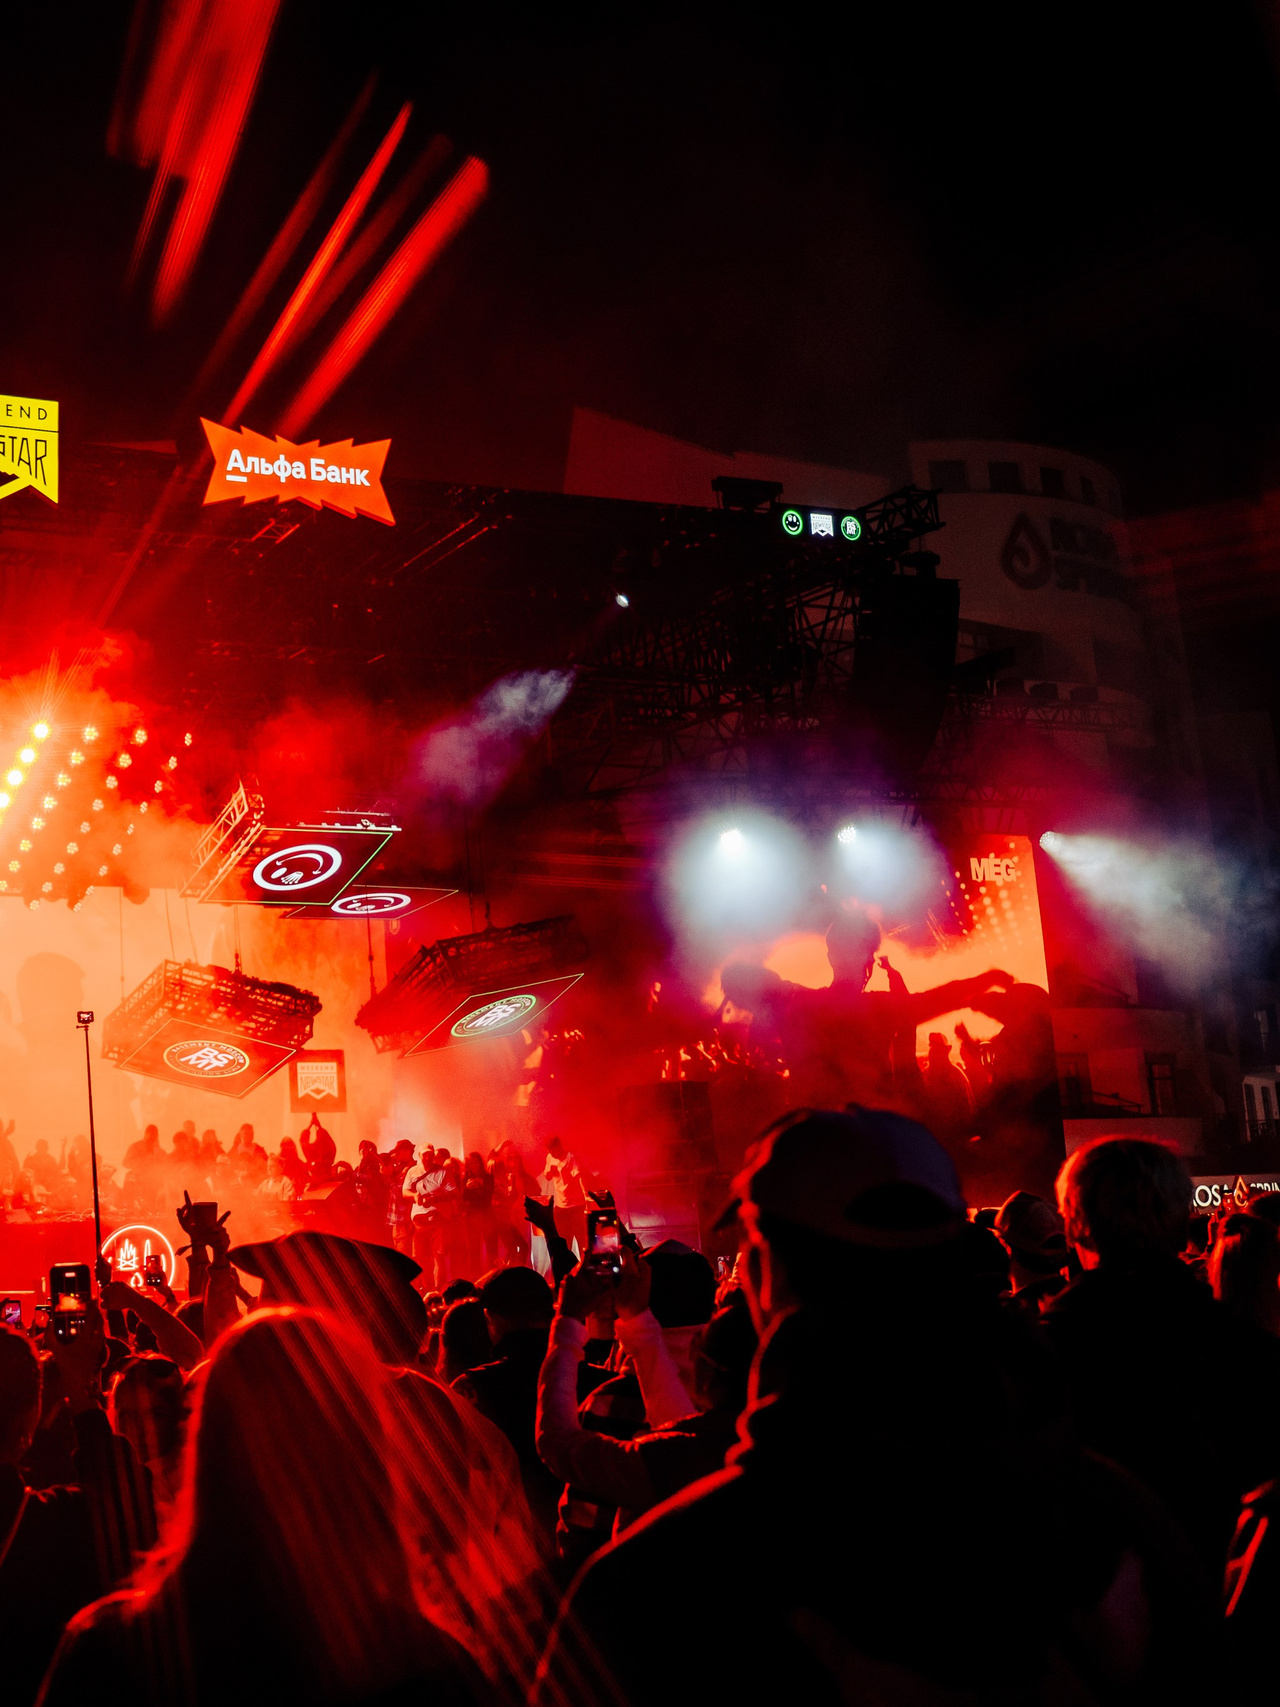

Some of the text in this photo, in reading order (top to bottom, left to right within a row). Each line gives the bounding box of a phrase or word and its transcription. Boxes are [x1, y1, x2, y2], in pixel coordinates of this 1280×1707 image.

[226, 449, 370, 487] Альфа Банк
[970, 858, 1017, 882] MEG
